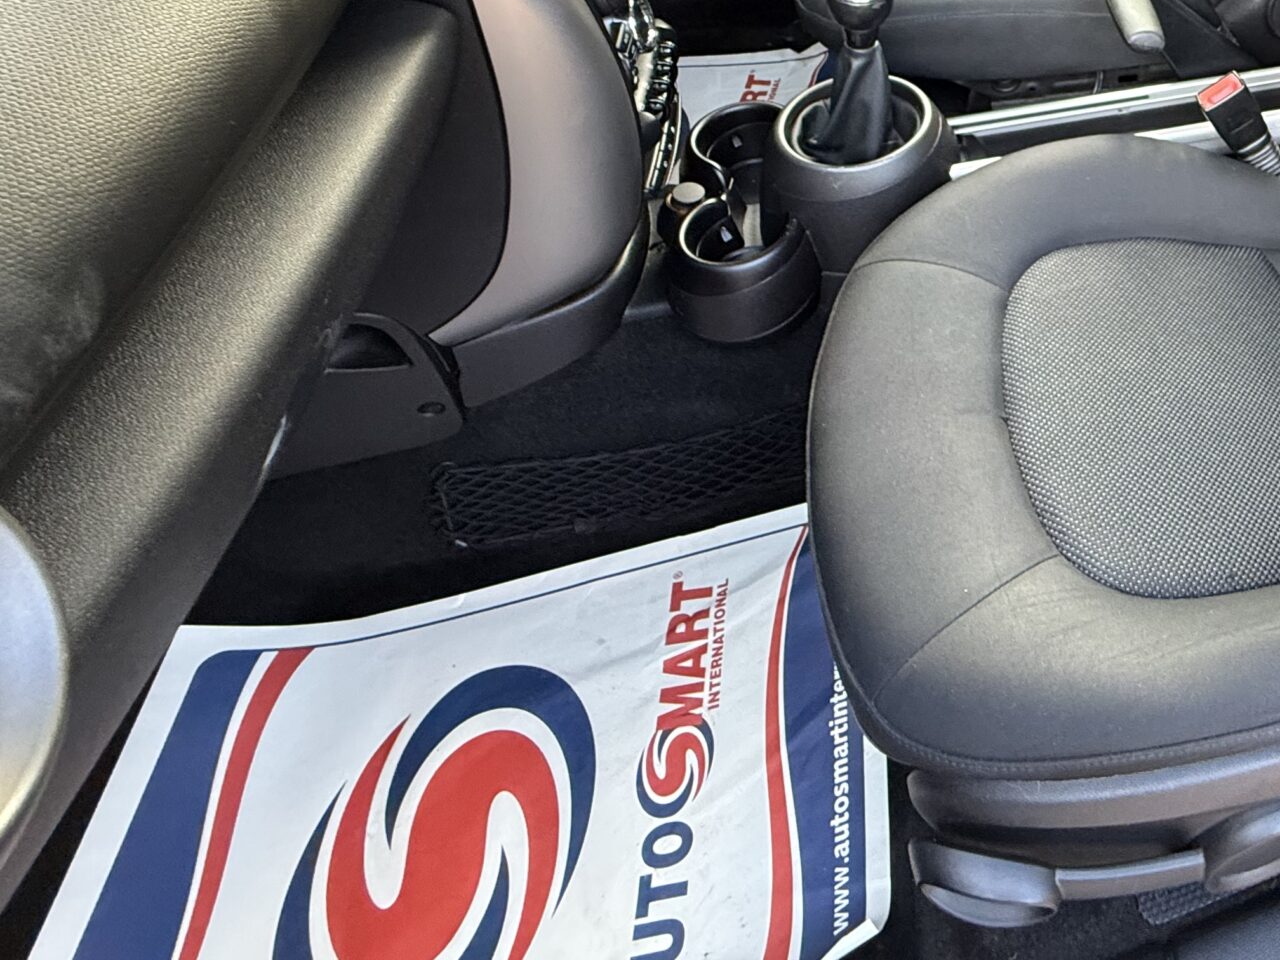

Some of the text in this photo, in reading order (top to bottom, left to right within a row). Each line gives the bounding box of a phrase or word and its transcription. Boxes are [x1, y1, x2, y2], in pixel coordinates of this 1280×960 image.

[630, 580, 714, 960] UTOSMART
[708, 578, 729, 710] INTERNATIONAL
[829, 661, 850, 936] www.autosmartinter
